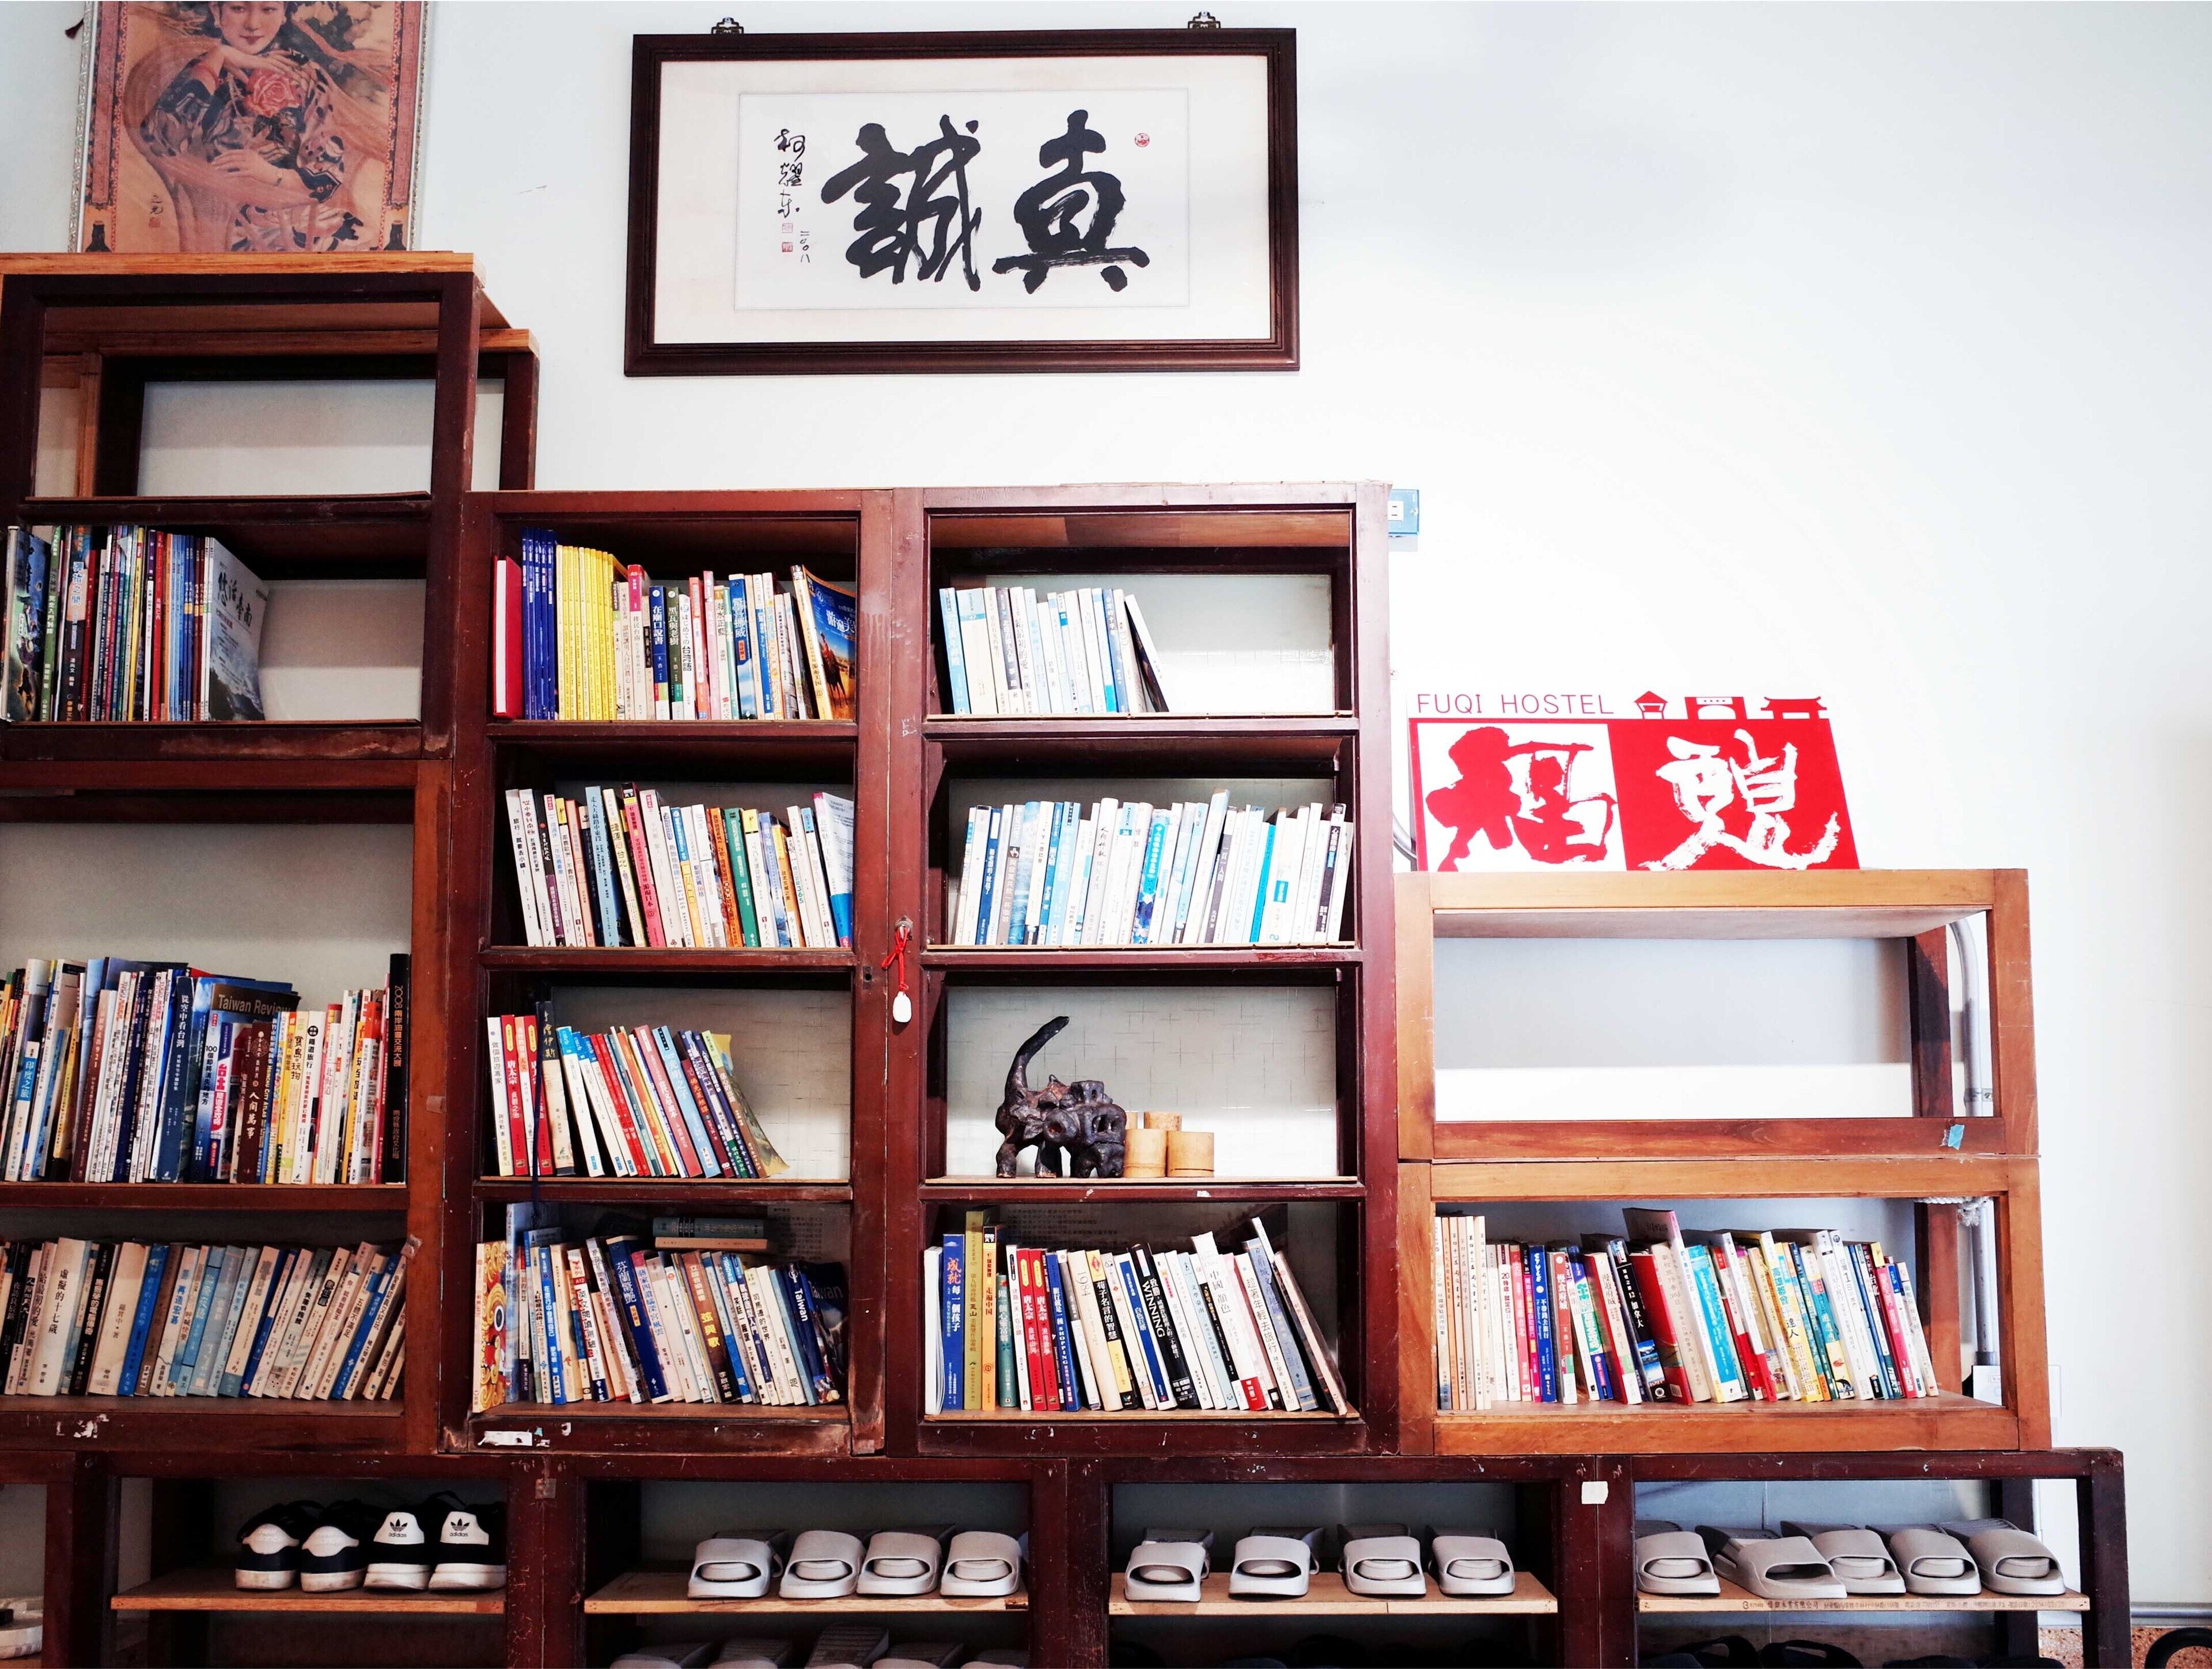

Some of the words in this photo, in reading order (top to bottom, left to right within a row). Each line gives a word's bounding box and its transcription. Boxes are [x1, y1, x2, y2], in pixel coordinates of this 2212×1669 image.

[653, 605, 664, 645] 在廟口說書
[1418, 693, 1482, 714] FUQI
[1501, 693, 1614, 714] HOSTEL
[176, 994, 190, 1048] 從空中看台灣
[218, 994, 251, 1012] Taiwan
[21, 1061, 35, 1098] 印度之旅
[247, 1092, 260, 1139] 人間萬事
[794, 1288, 808, 1322] Taiwan
[1142, 1280, 1165, 1338] WINNING
